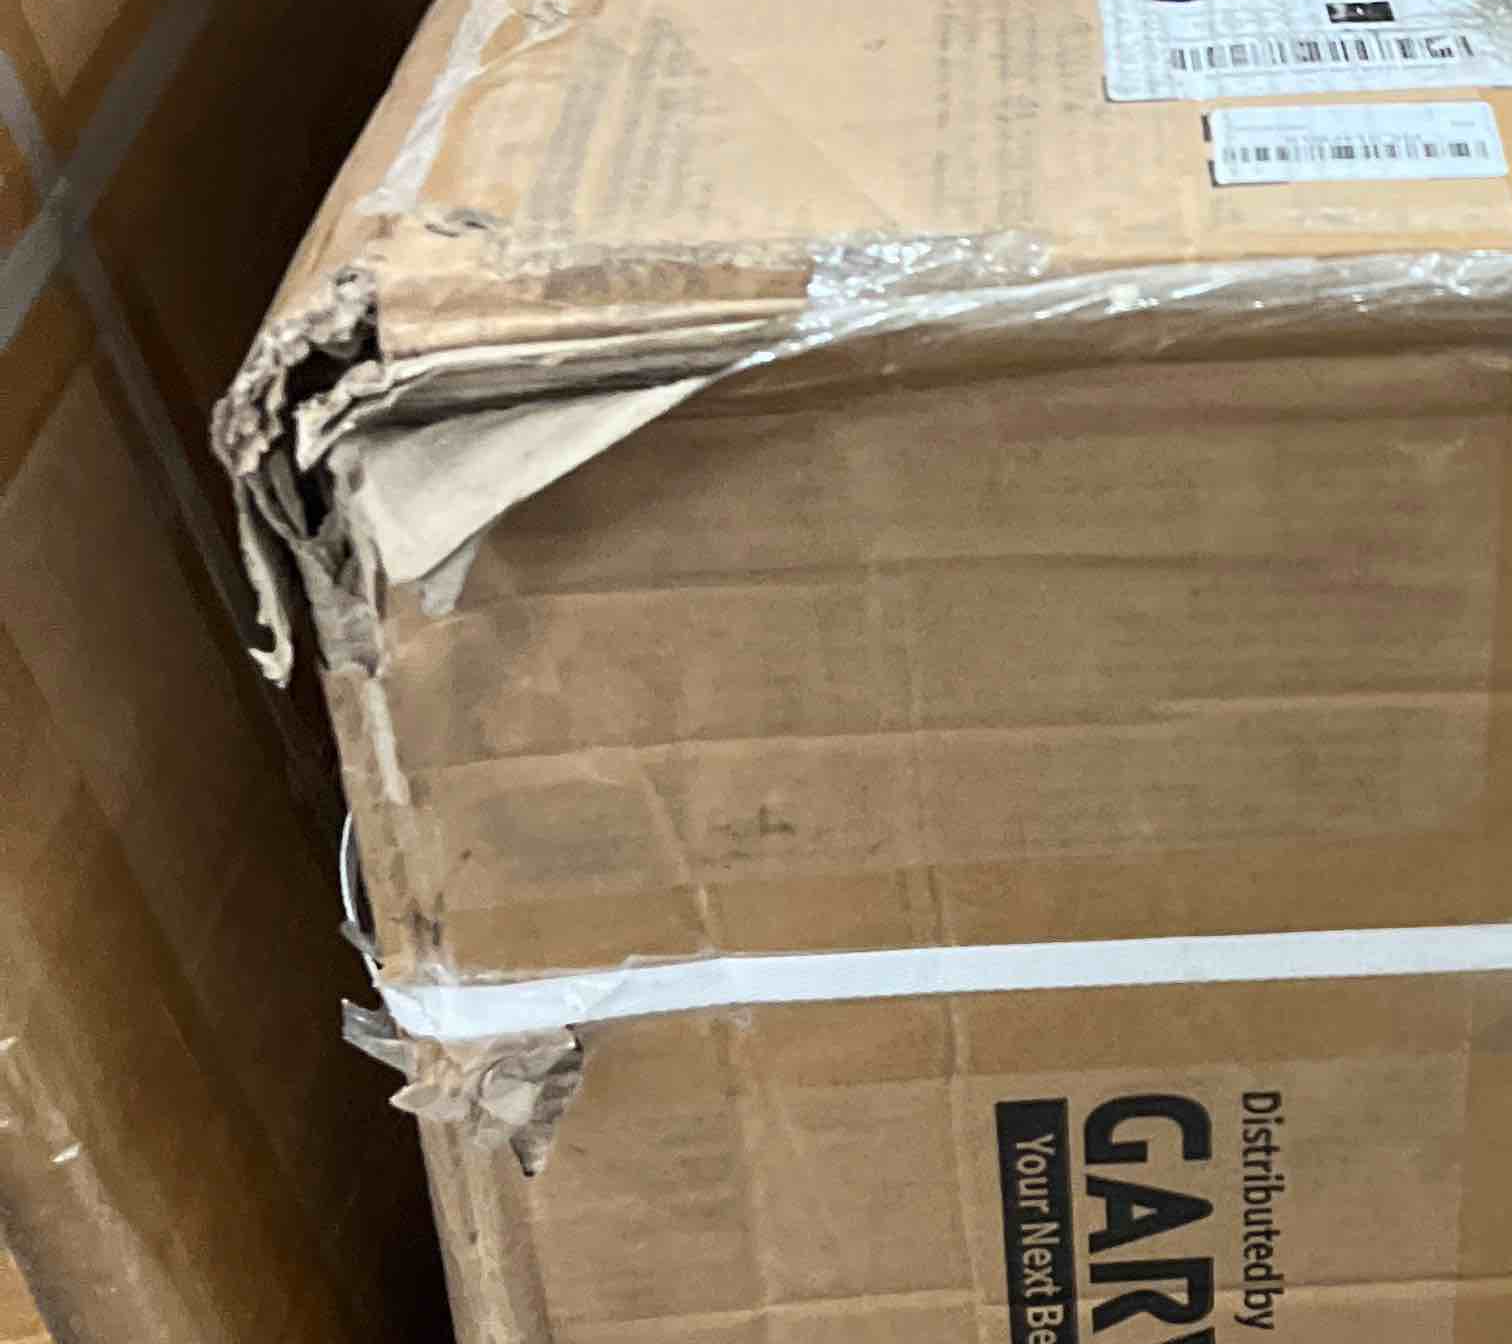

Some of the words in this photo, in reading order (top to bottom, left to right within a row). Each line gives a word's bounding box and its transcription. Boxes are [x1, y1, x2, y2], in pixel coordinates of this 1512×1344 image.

[1014, 1134, 1055, 1212] Your
[1239, 1090, 1284, 1280] Distributed
[1020, 1222, 1060, 1298] Next
[1235, 1283, 1284, 1331] by
